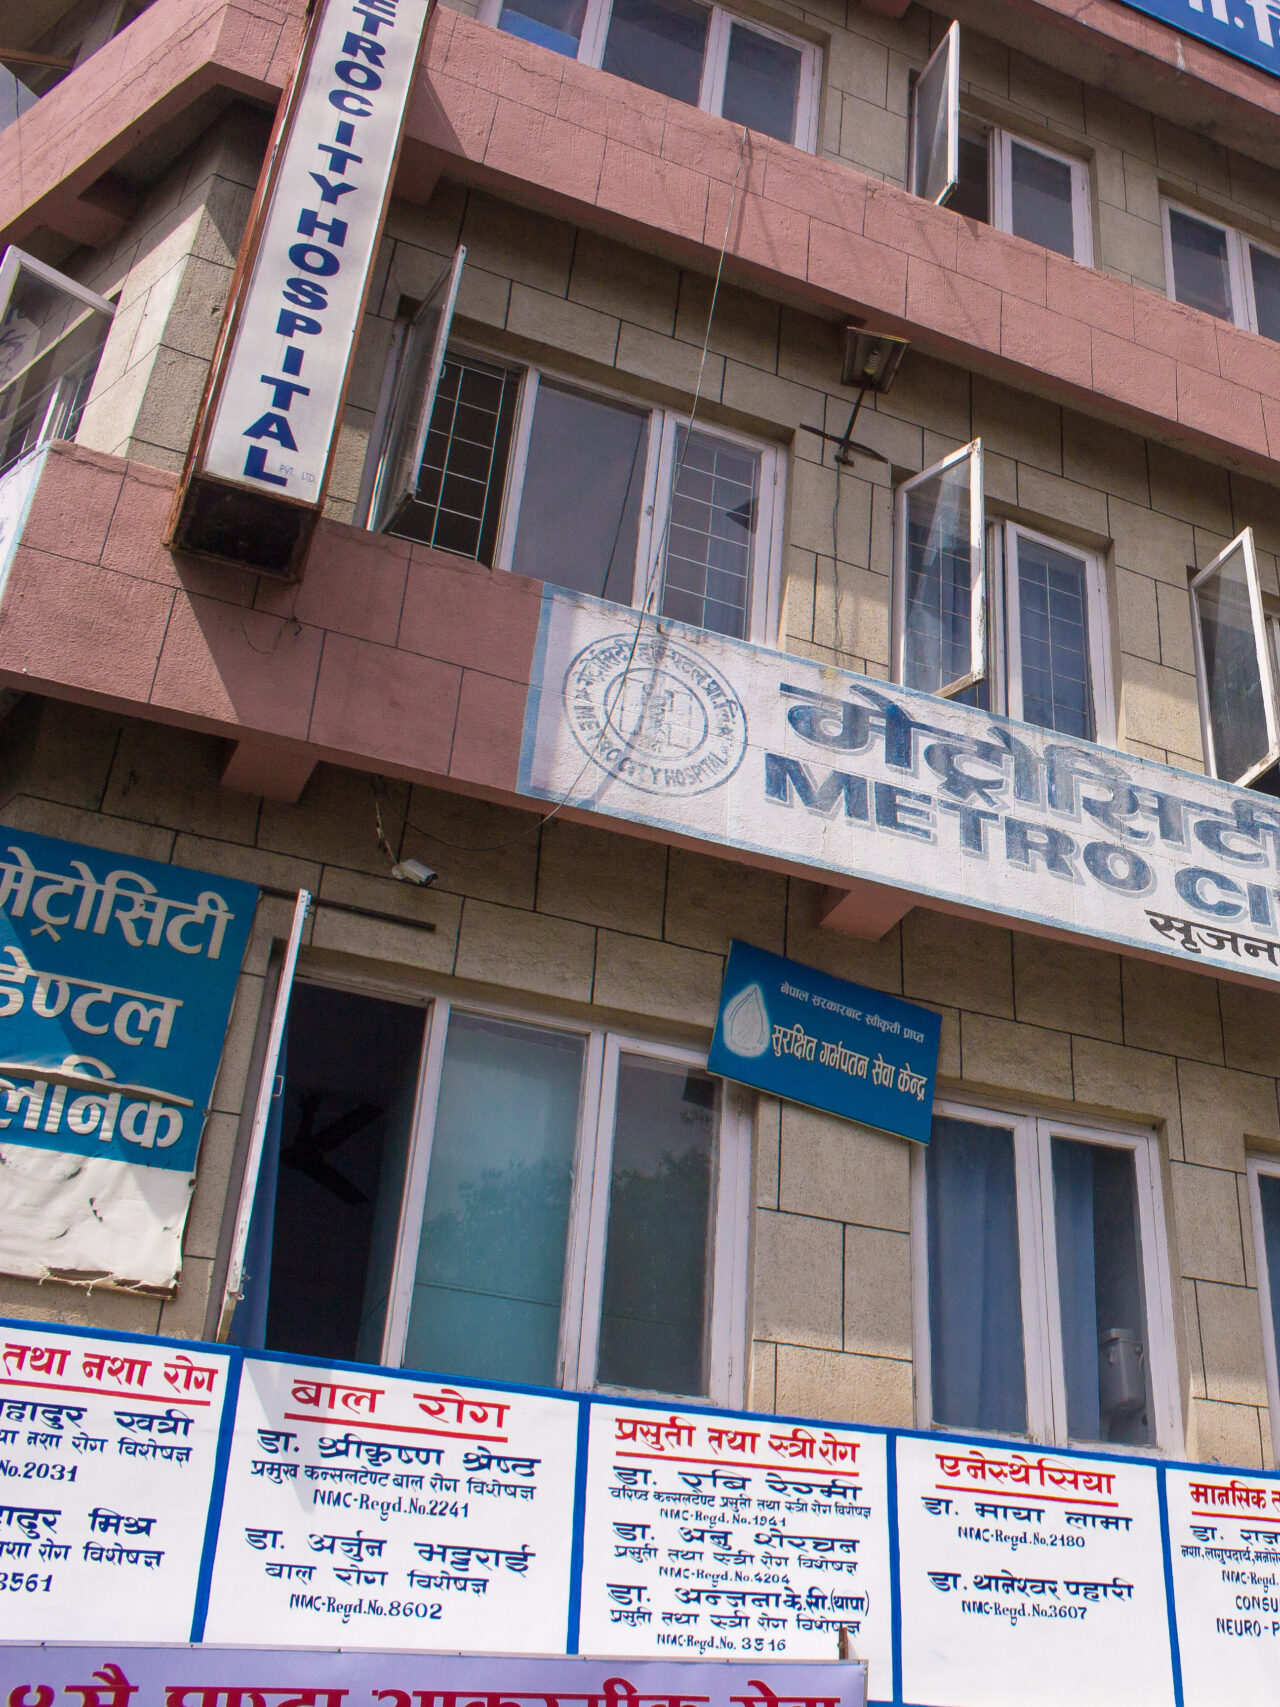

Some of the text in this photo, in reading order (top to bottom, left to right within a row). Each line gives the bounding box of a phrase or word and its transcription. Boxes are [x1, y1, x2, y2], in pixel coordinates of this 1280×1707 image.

[243, 209, 348, 487] HOSPITAL
[780, 981, 809, 1002] नेपाल
[811, 993, 862, 1022] सरकारबाट
[903, 1026, 925, 1044] प्राप्त
[771, 1023, 928, 1101] सुरक्षित गर्भपतन सेवा केन्द्र
[2, 1343, 219, 1393] तथा नशा रोग
[291, 1379, 511, 1428] बाल रोग
[114, 1409, 195, 1437] खत्री
[615, 1416, 761, 1454] प्रसुती तथा
[26, 1431, 193, 1467] नशा रोग विशेषज्ञ
[257, 1429, 300, 1454] डा.
[318, 1433, 445, 1467] श्रीकृष्ण
[250, 1460, 300, 1485] प्रमुख
[392, 1474, 425, 1490] बाल
[429, 1472, 460, 1493] रोग
[466, 1477, 537, 1500] विशेषज्ञ
[612, 1465, 657, 1486] डा.
[756, 1499, 781, 1511] तथा
[811, 1499, 832, 1514] रोग
[1189, 1479, 1266, 1509] मानसिक
[921, 1496, 1133, 1531] डा. माया लामा
[245, 1528, 285, 1551] डा.
[308, 1530, 387, 1563] अर्जुन
[612, 1522, 860, 1554] डा. अनु शेरचन
[1189, 1525, 1224, 1543] डा.
[38, 1538, 165, 1569] रोग विशेषज्ञ
[265, 1562, 489, 1595] बाल रोग विशेषज्ञ
[606, 1583, 650, 1606] डा.
[927, 1571, 967, 1592] डा.
